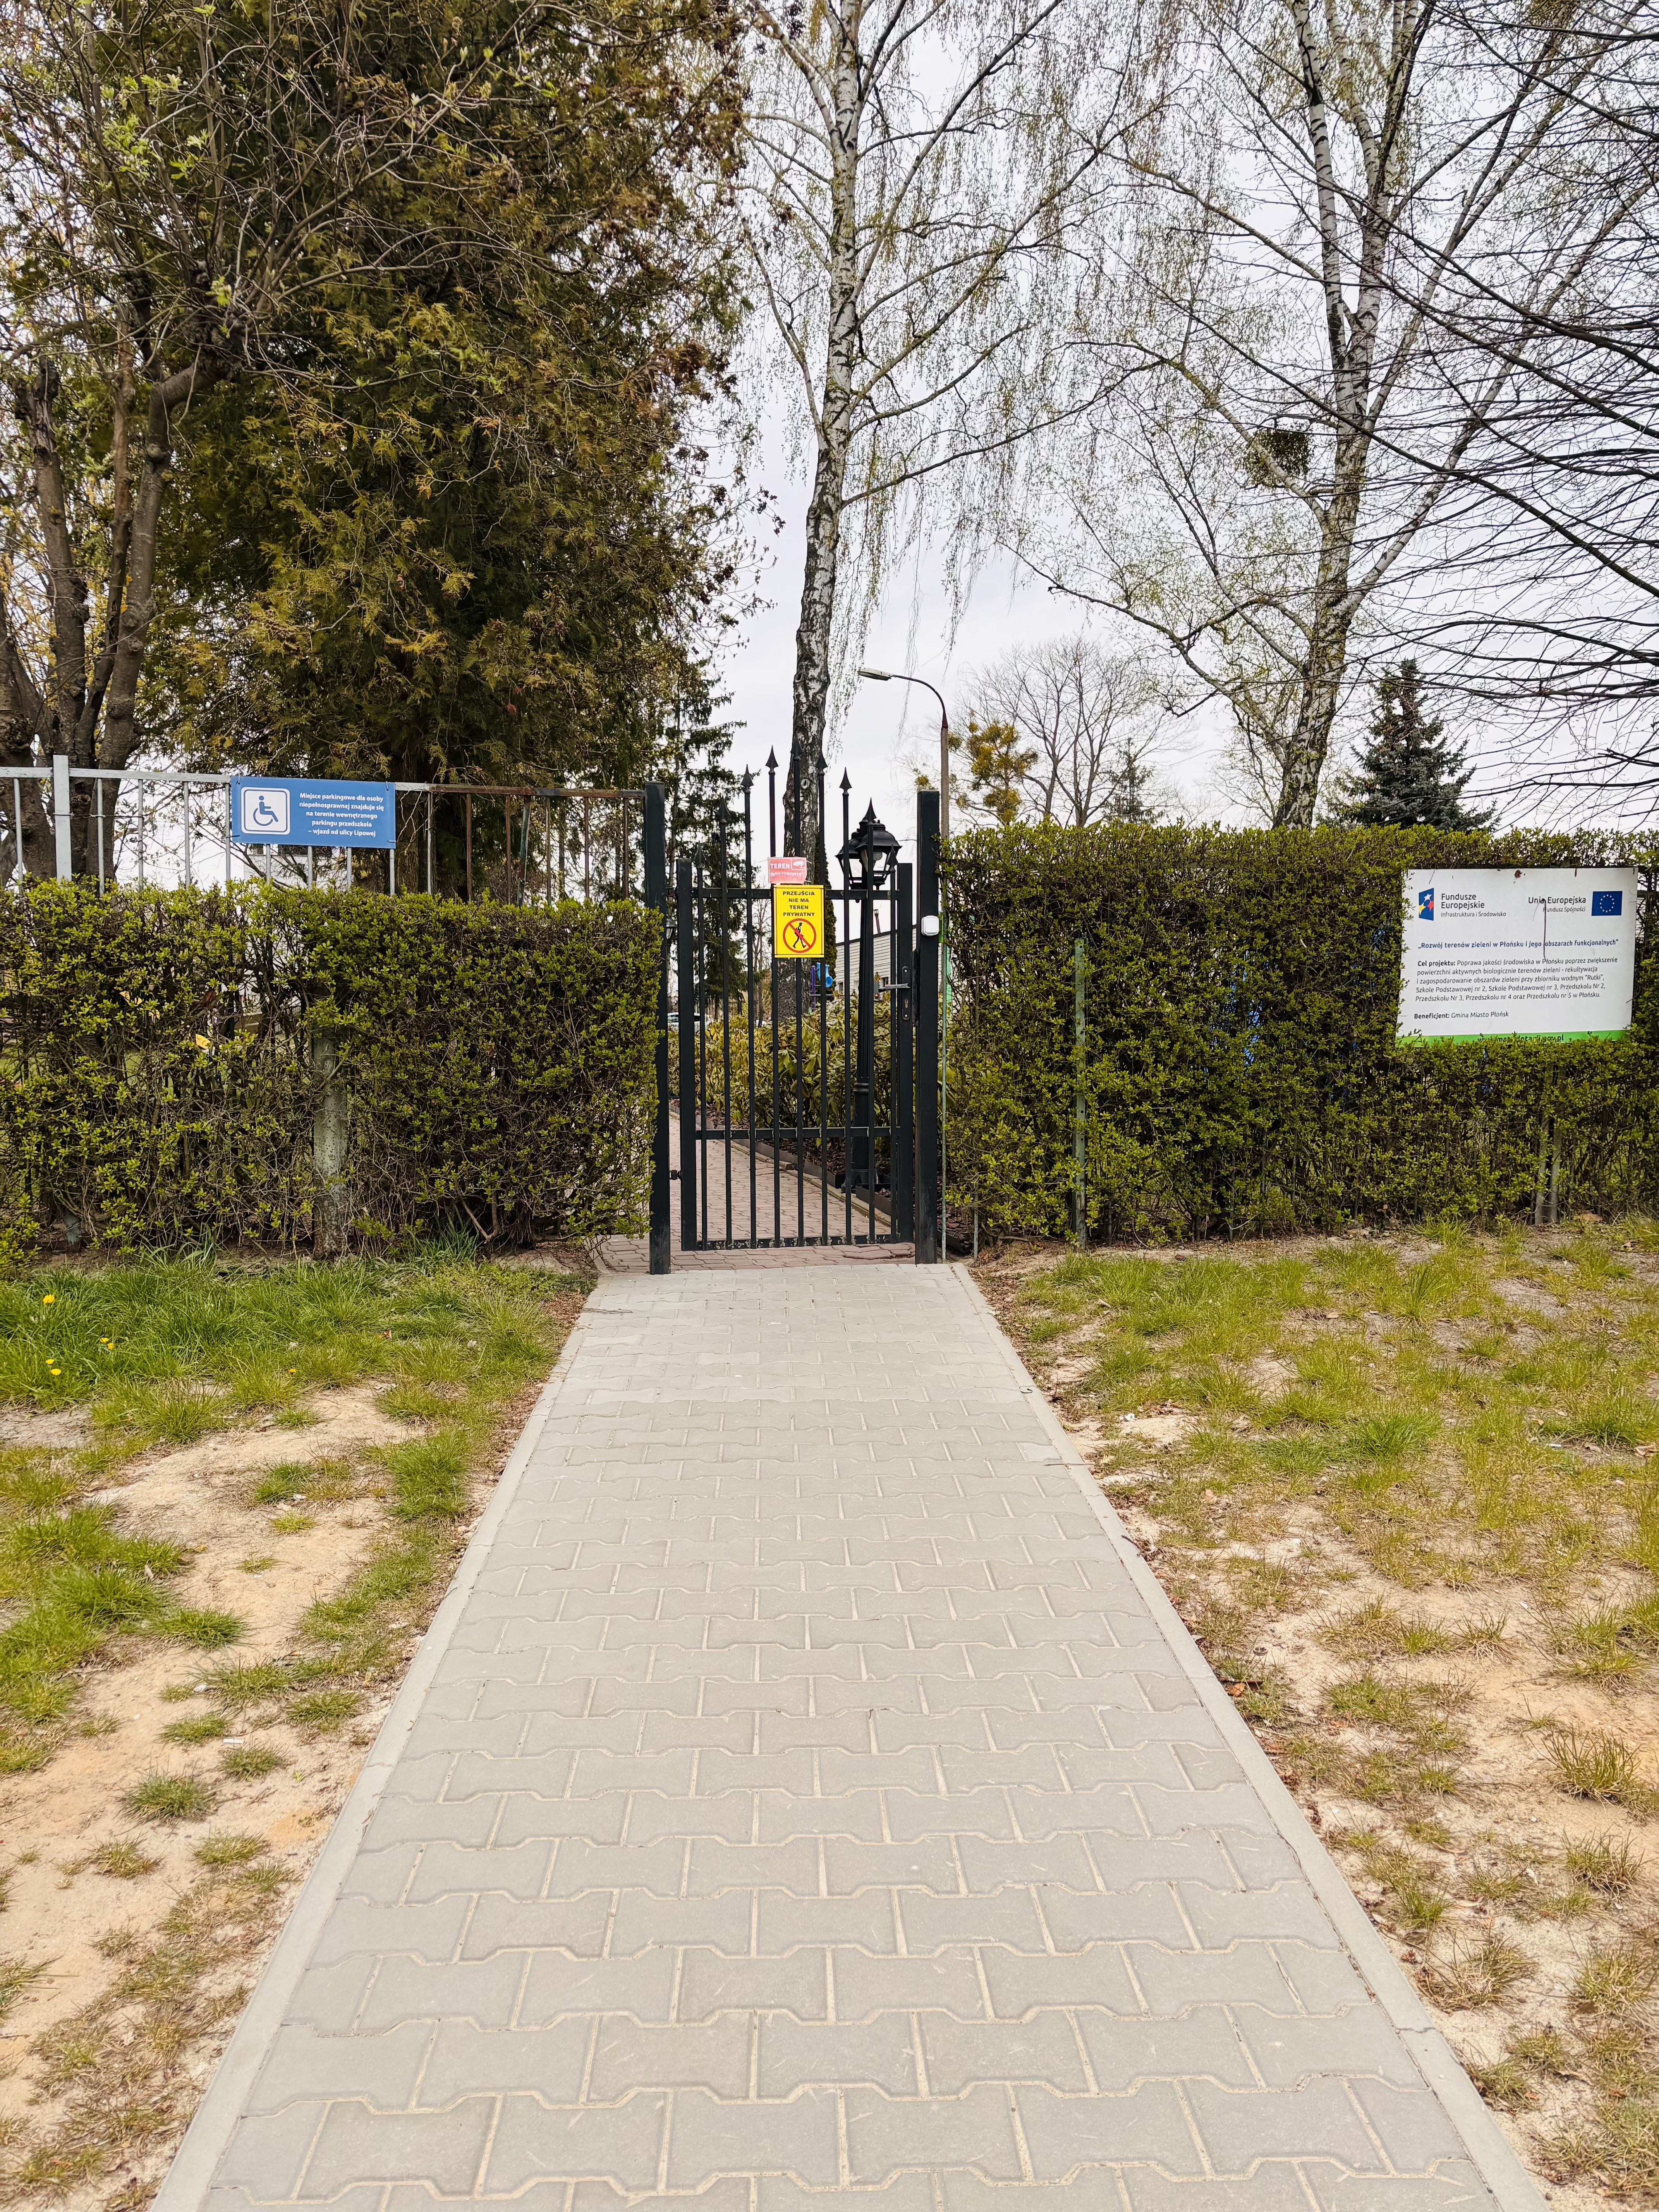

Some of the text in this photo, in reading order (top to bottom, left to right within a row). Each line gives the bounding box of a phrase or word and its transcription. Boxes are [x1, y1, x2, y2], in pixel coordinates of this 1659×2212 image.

[299, 802, 350, 810] niepełnosprawnej
[1547, 896, 1586, 905] Europejska
[1441, 901, 1485, 910] Europejskie
